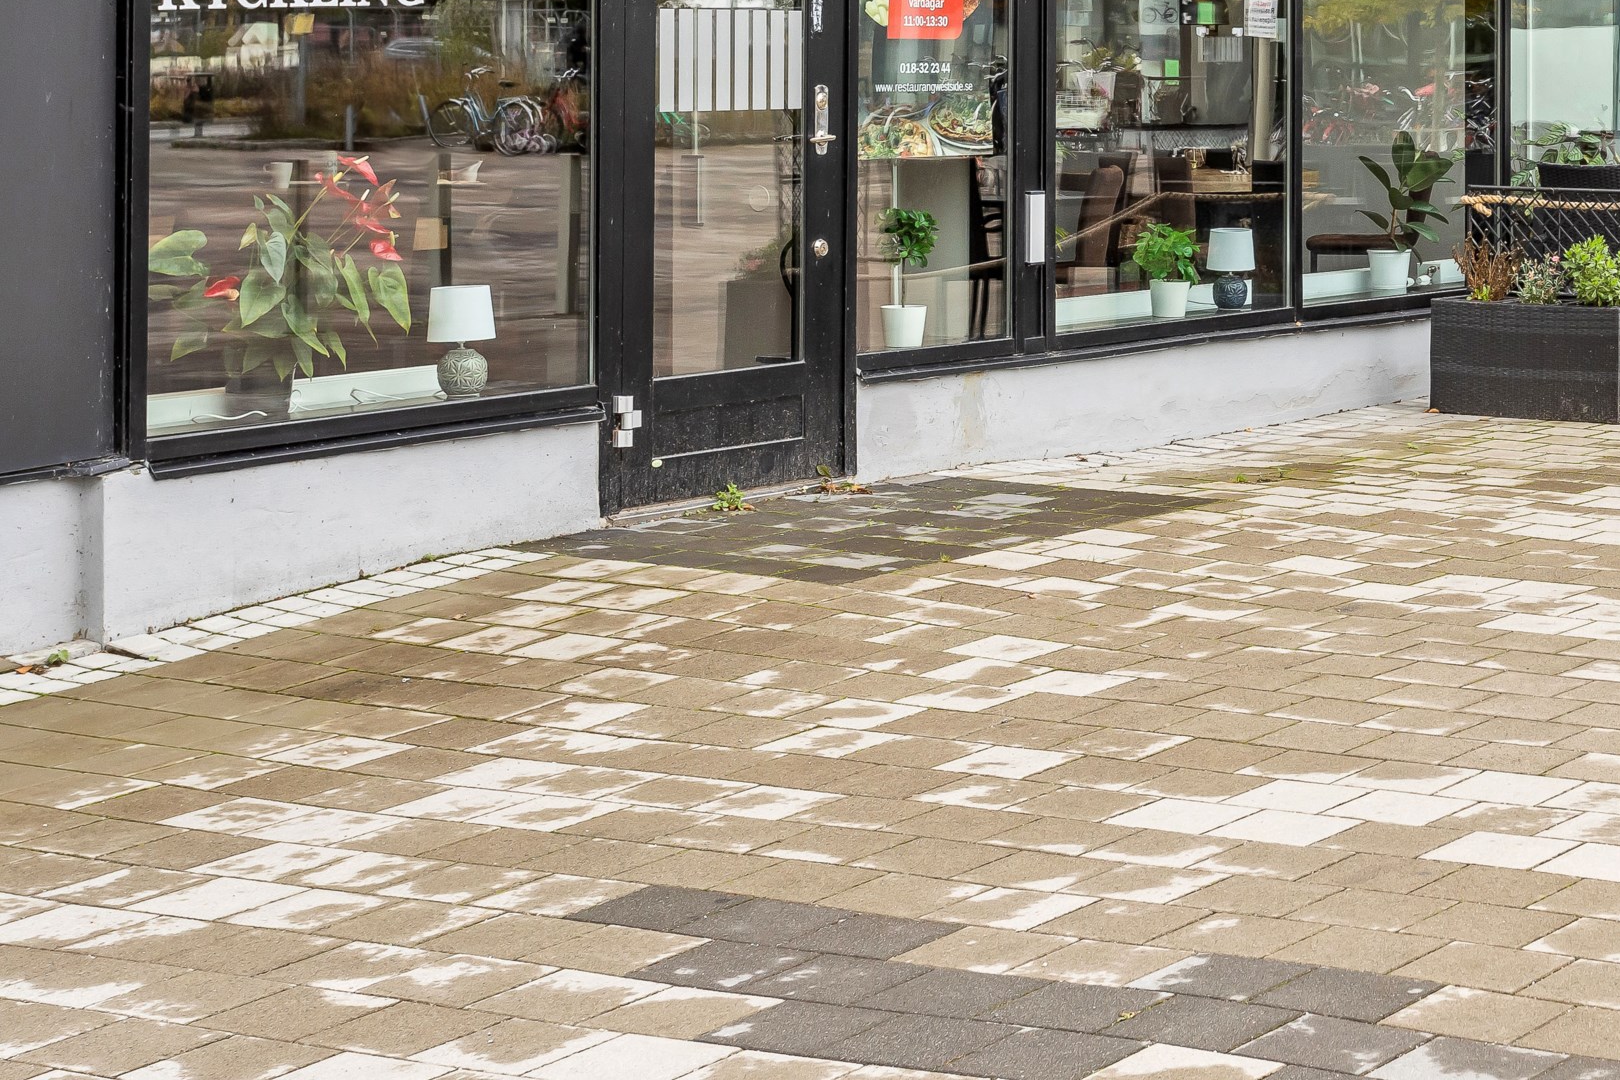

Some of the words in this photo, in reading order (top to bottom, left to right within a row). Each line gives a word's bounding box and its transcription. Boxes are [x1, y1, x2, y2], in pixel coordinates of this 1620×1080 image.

[903, 15, 948, 27] 11:00-13:30
[900, 62, 930, 74] 018-32
[930, 62, 940, 74] 23
[941, 62, 951, 74] 44
[875, 80, 973, 93] www.restaurangwestside.se
